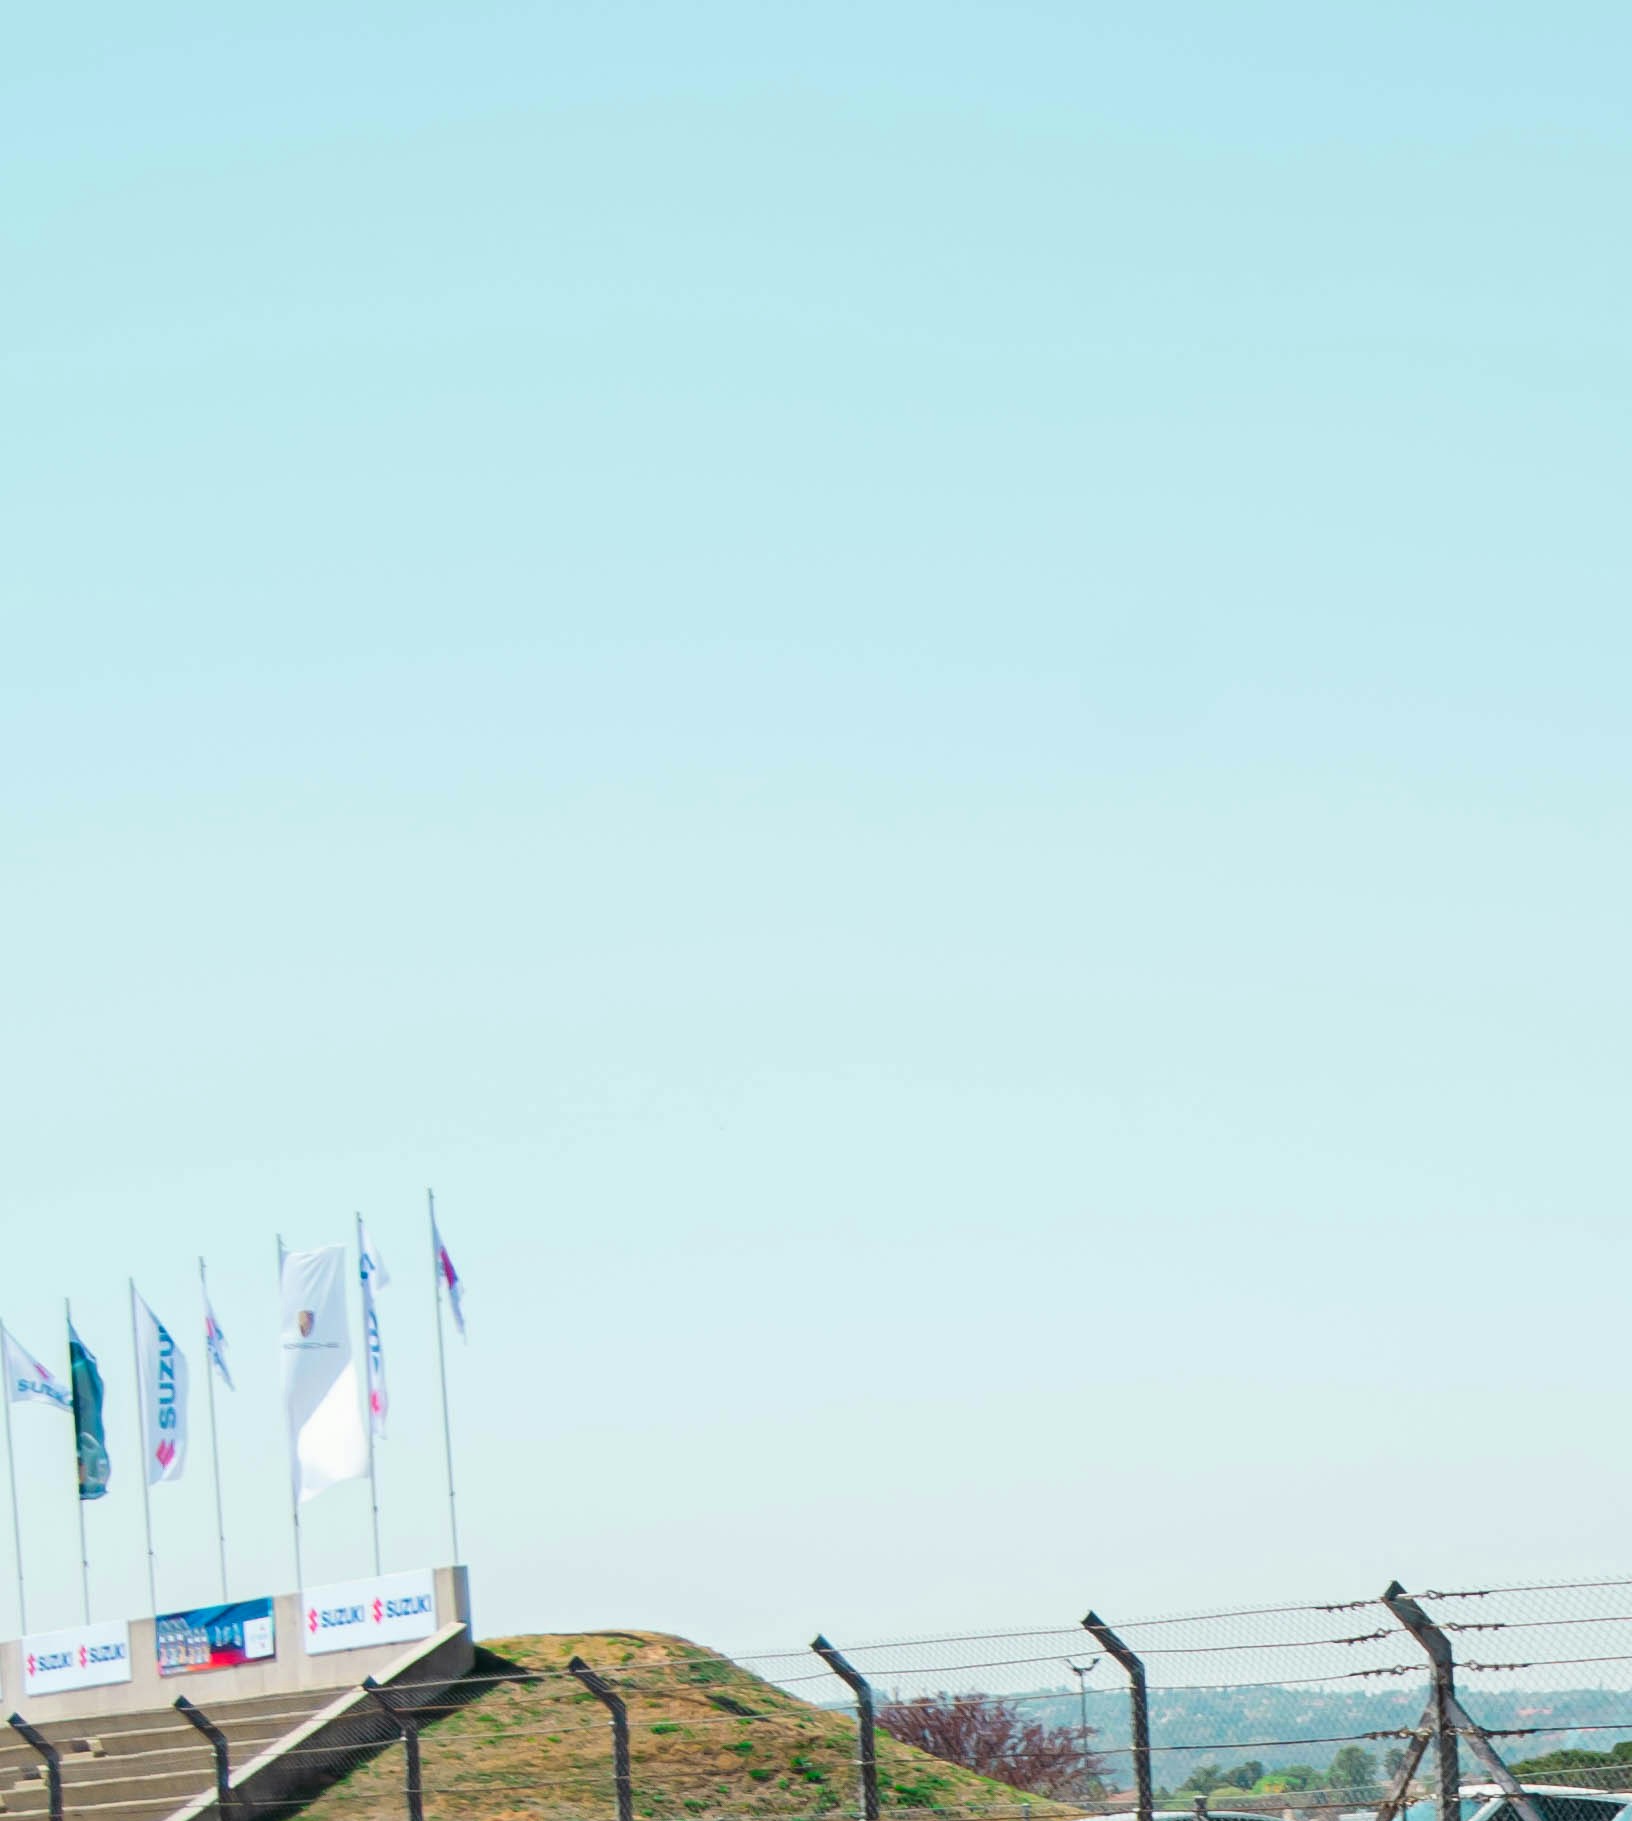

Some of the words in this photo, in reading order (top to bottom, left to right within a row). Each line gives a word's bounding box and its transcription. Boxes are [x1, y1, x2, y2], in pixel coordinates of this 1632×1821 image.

[321, 1605, 365, 1628] SUZUKI
[386, 1595, 432, 1618] SUZUKI
[38, 1651, 73, 1671] SUZUKI
[90, 1643, 125, 1663] SUZUKI
